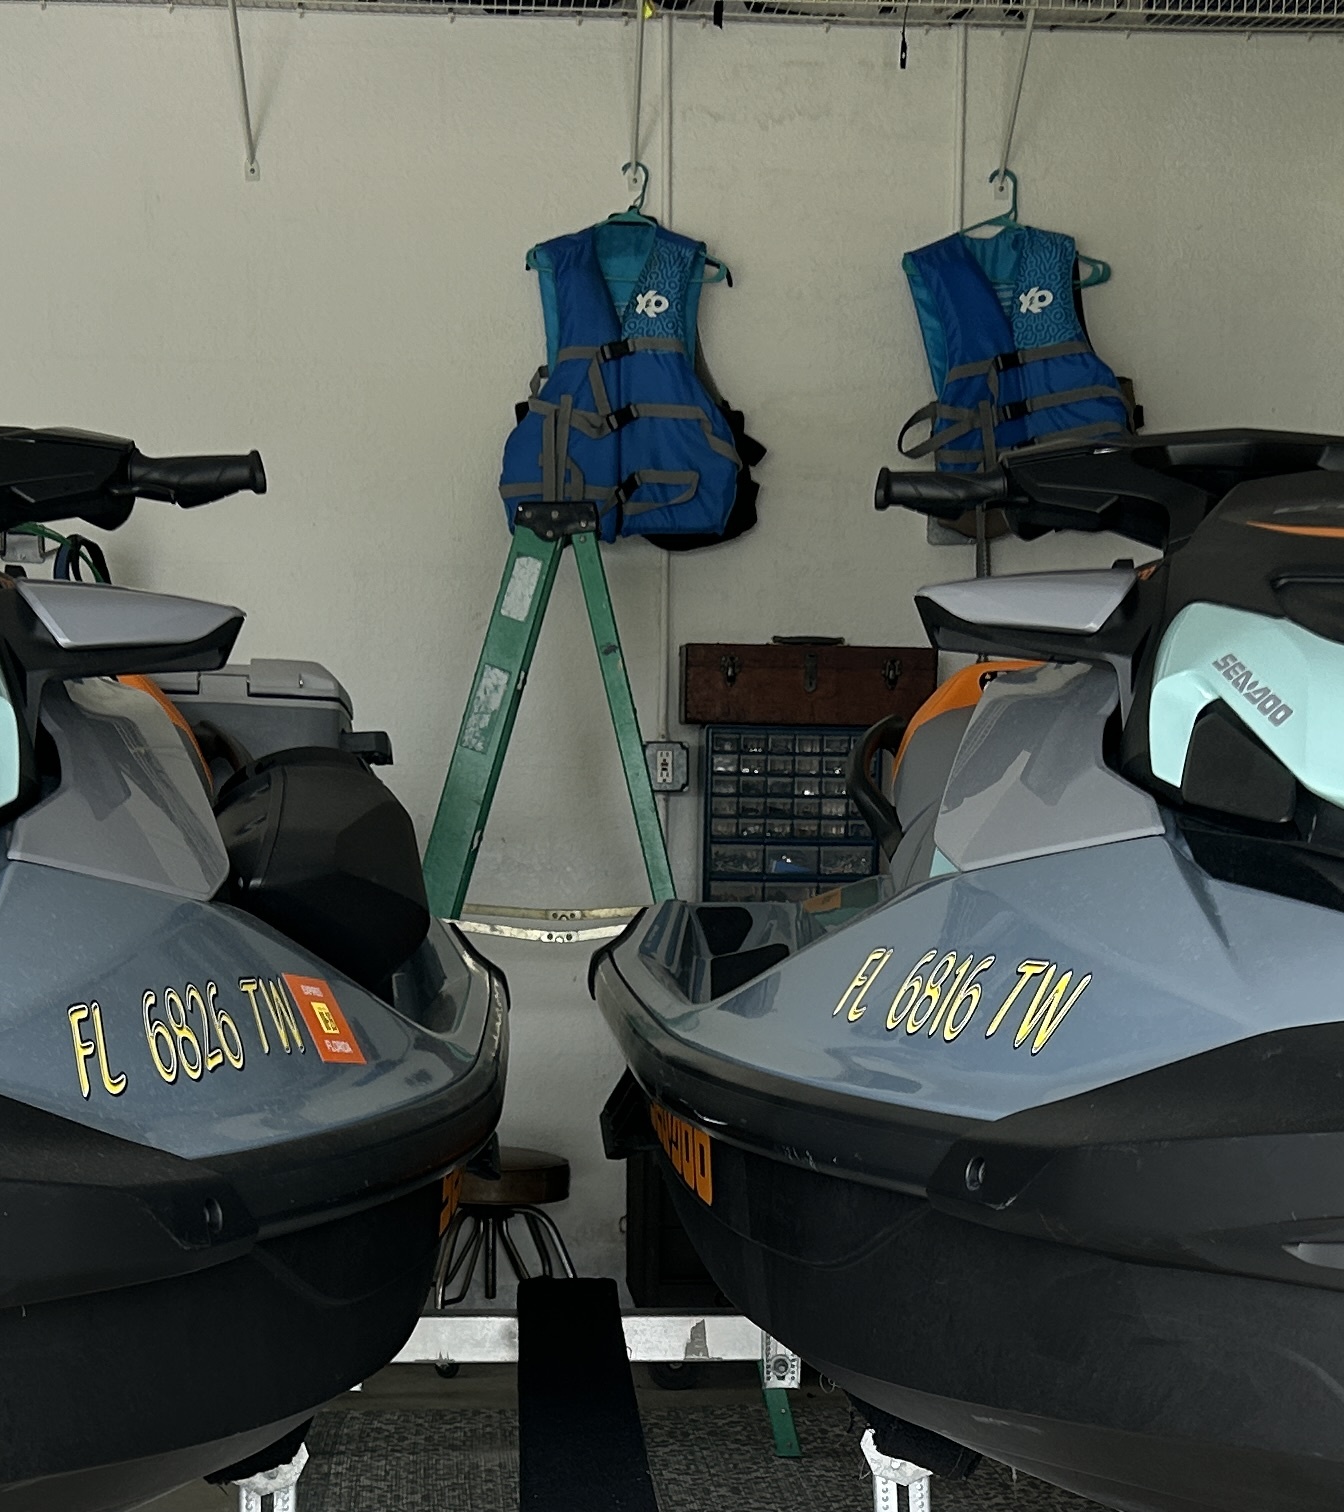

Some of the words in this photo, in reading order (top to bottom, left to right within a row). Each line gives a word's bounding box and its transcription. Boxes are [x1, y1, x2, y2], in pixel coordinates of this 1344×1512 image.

[67, 1000, 128, 1099] FL
[142, 980, 244, 1084] 6826
[239, 976, 306, 1055] TW
[832, 946, 894, 1022] FL
[886, 948, 996, 1043] 6816
[985, 958, 1093, 1057] TW
